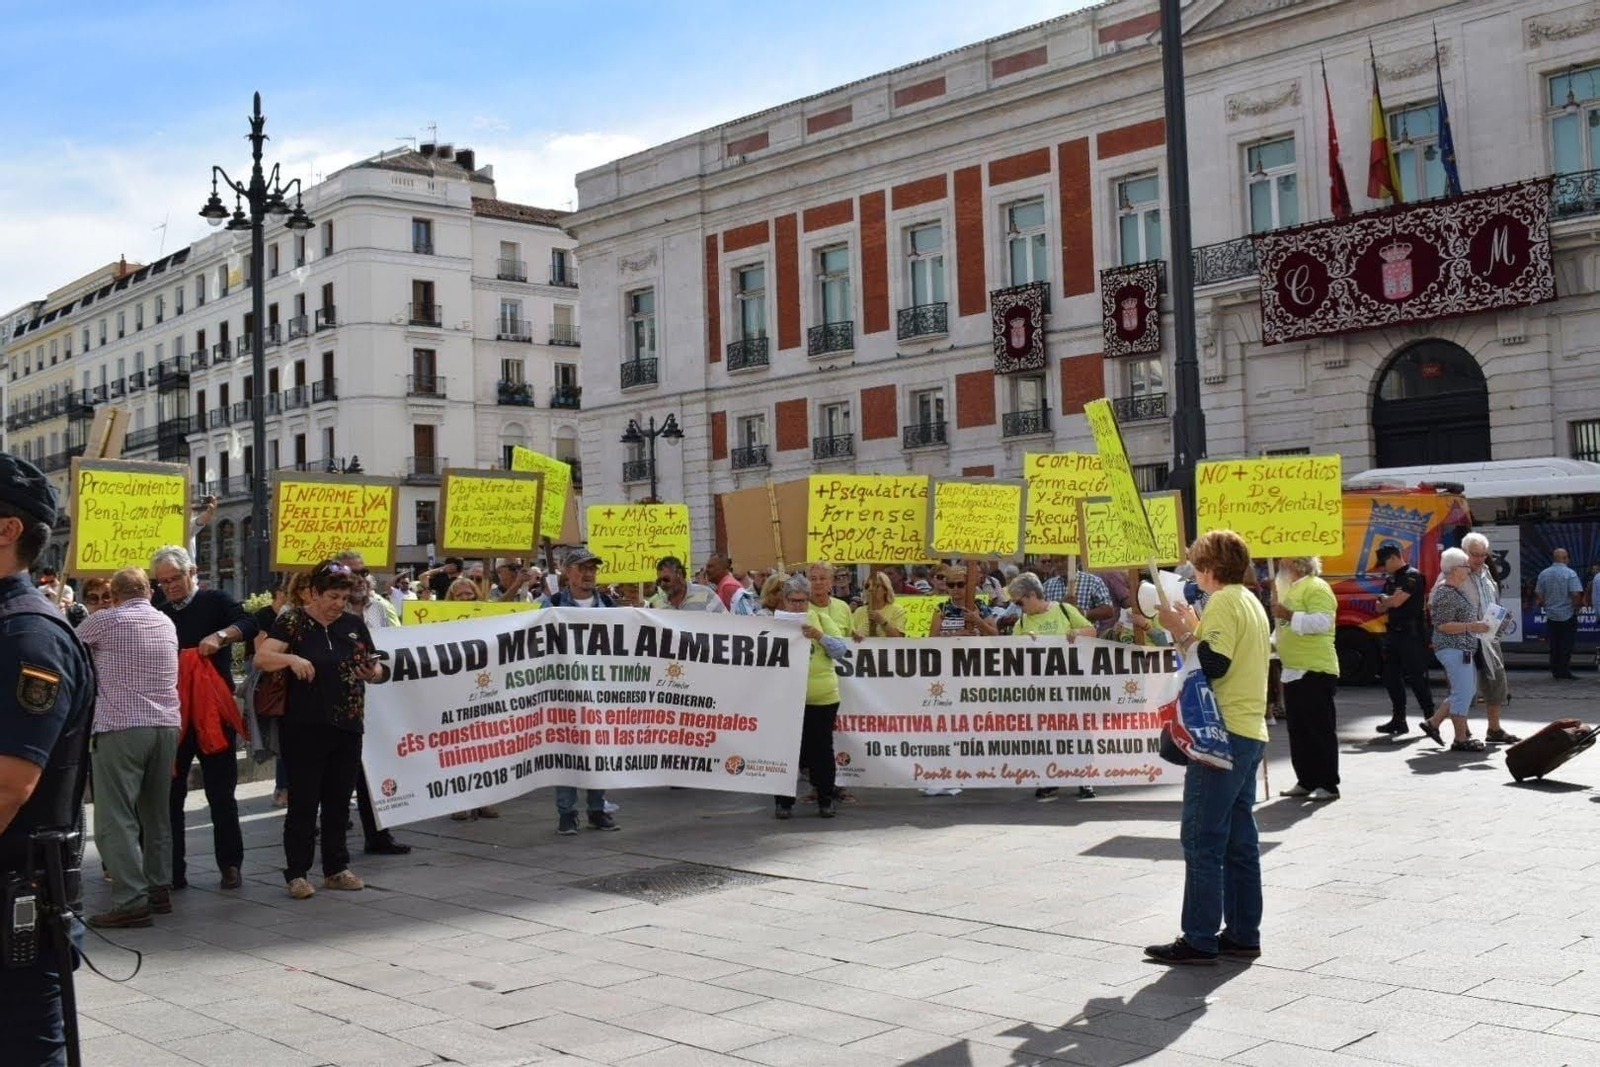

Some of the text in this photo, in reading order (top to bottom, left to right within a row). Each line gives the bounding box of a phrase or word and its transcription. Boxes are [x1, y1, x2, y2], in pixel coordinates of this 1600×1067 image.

[80, 471, 181, 496] Procedimiento
[1199, 464, 1229, 485] NO
[821, 503, 915, 523] Forense
[112, 520, 162, 540] Pericial
[591, 519, 688, 544] Investigación
[376, 623, 790, 684] SALUD MENTAL ALMERÍA
[835, 647, 1177, 678] SALUD MENTAL ALME
[505, 661, 651, 689] ASOCIACIÓN EL TIMÓN
[960, 684, 1111, 703] ASOCIACIÓN EL TIMÓN
[441, 708, 454, 725] AL
[457, 700, 508, 721] TRIBUNAL
[597, 690, 646, 704] CONGRESO
[649, 691, 655, 702] Y
[657, 692, 716, 709] GOBIERNO:
[397, 707, 758, 758] ¿Es constitucional que los enfermos mentales
[833, 711, 1162, 733] ALTERNATIVA A LA CÁRCEL PARA EL ENFERM
[438, 725, 717, 768] inimputables estén en las cárceles?
[865, 741, 881, 757] 10
[988, 739, 1053, 756] MUNDIAL
[1056, 739, 1074, 755] DE
[1077, 740, 1094, 754] LA
[1097, 738, 1142, 754] SALUD
[426, 768, 508, 799] 10/10/2018
[534, 753, 591, 772] MUNDIAL
[610, 755, 622, 771] LA
[625, 755, 658, 771] SALUD
[914, 763, 953, 781] Ponte
[955, 769, 972, 779] en
[976, 767, 995, 779] mi
[1104, 764, 1162, 782] conmigo
